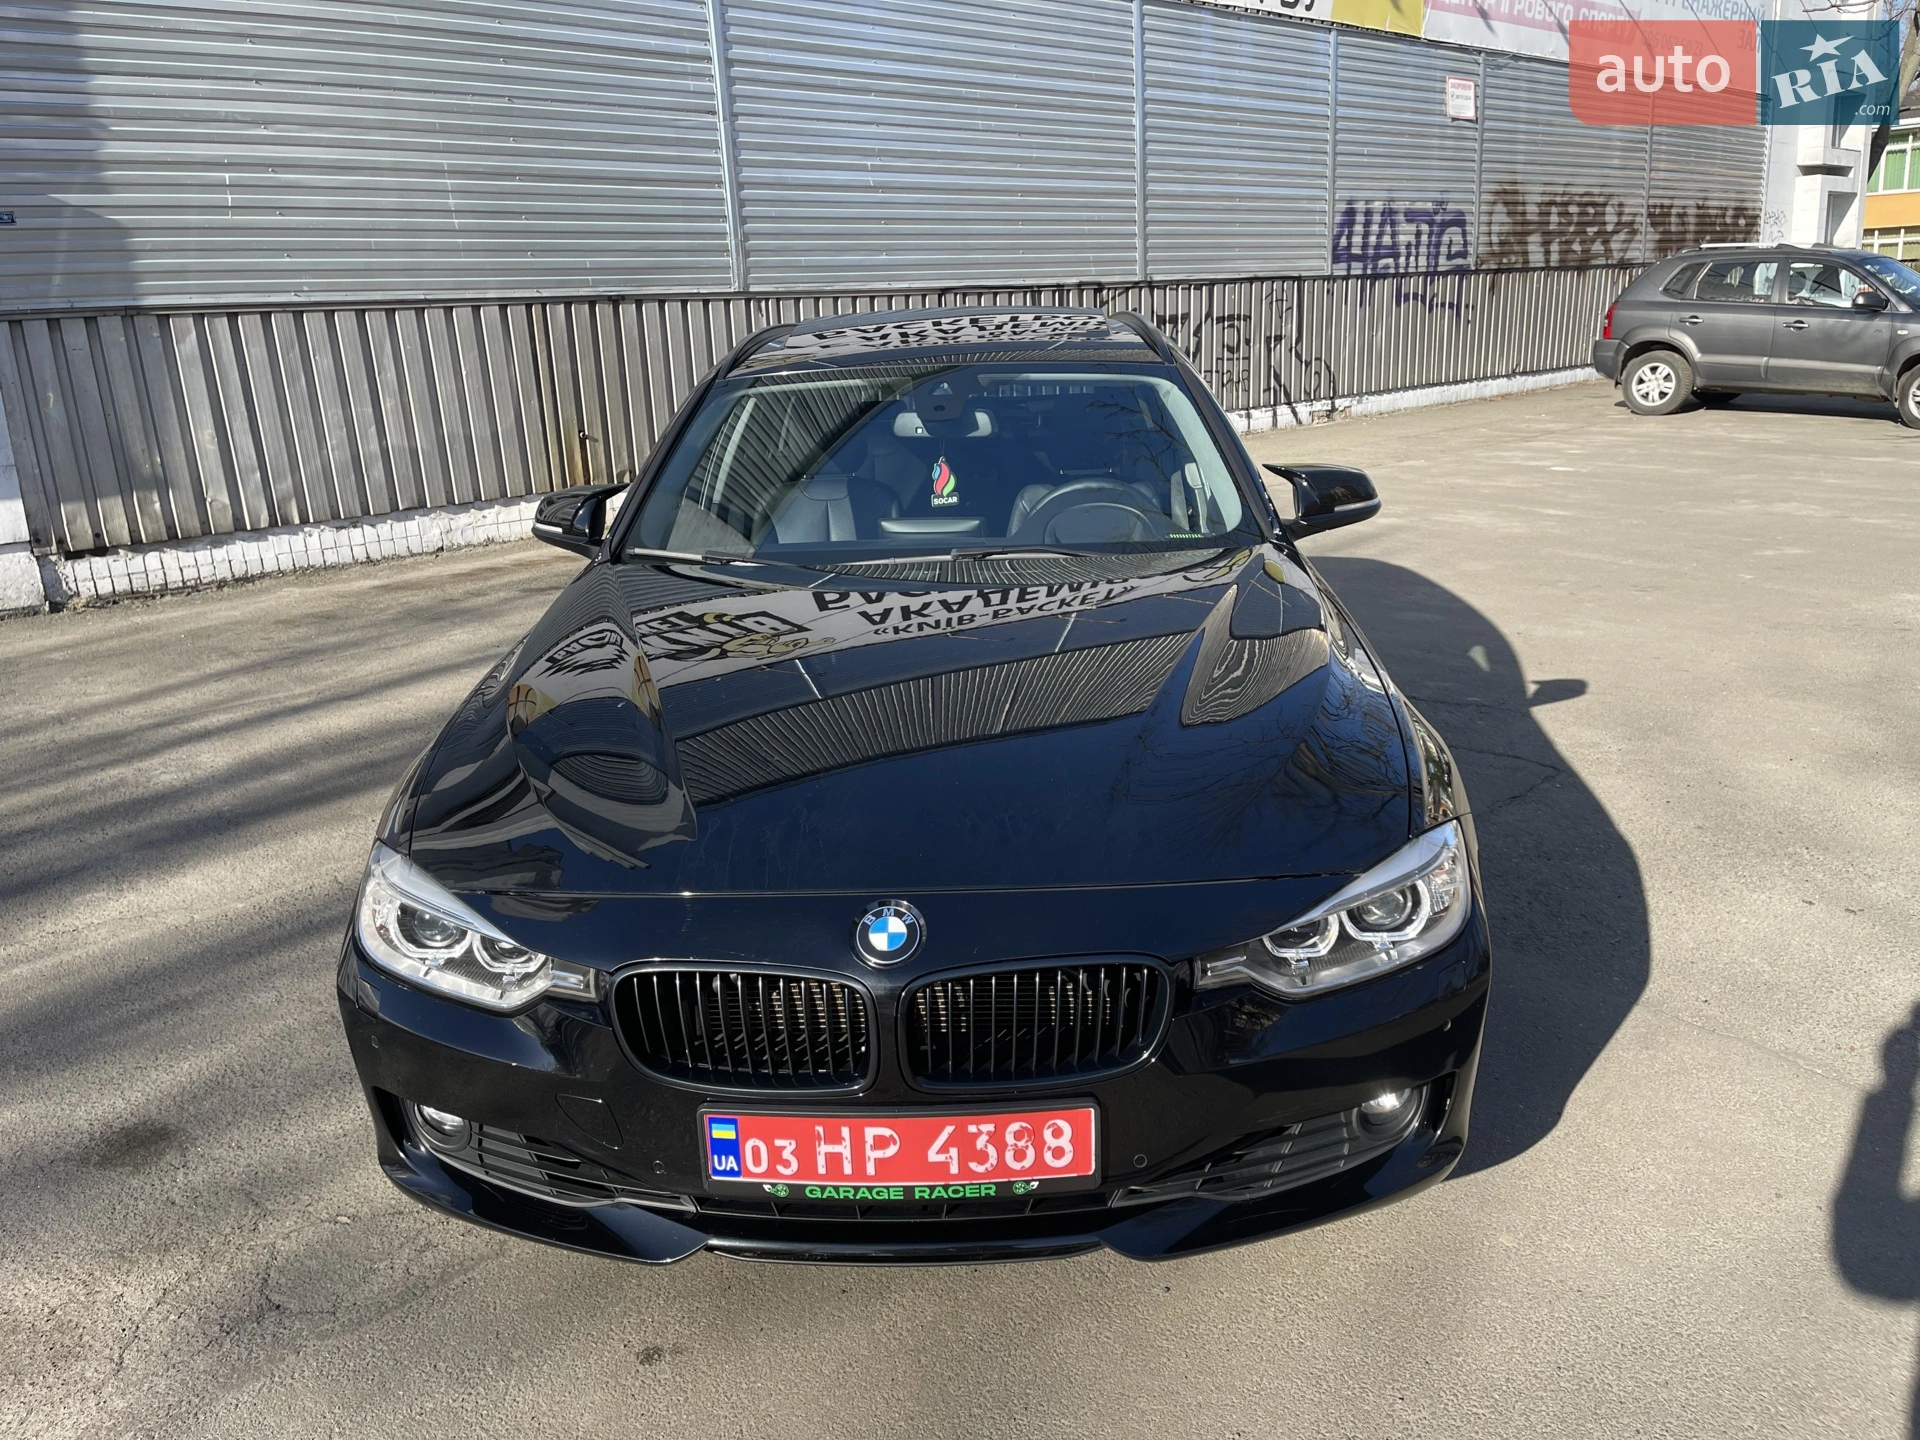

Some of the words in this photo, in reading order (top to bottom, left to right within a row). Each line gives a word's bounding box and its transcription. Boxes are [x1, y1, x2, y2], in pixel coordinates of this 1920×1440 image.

[933, 496, 958, 505] SOCAR
[863, 906, 914, 926] BMW
[713, 1155, 739, 1171] UA
[744, 1138, 799, 1175] 03
[814, 1125, 901, 1176] HP
[927, 1119, 1074, 1174] 4388
[805, 1185, 904, 1200] GARAGE
[914, 1183, 996, 1199] RACER
